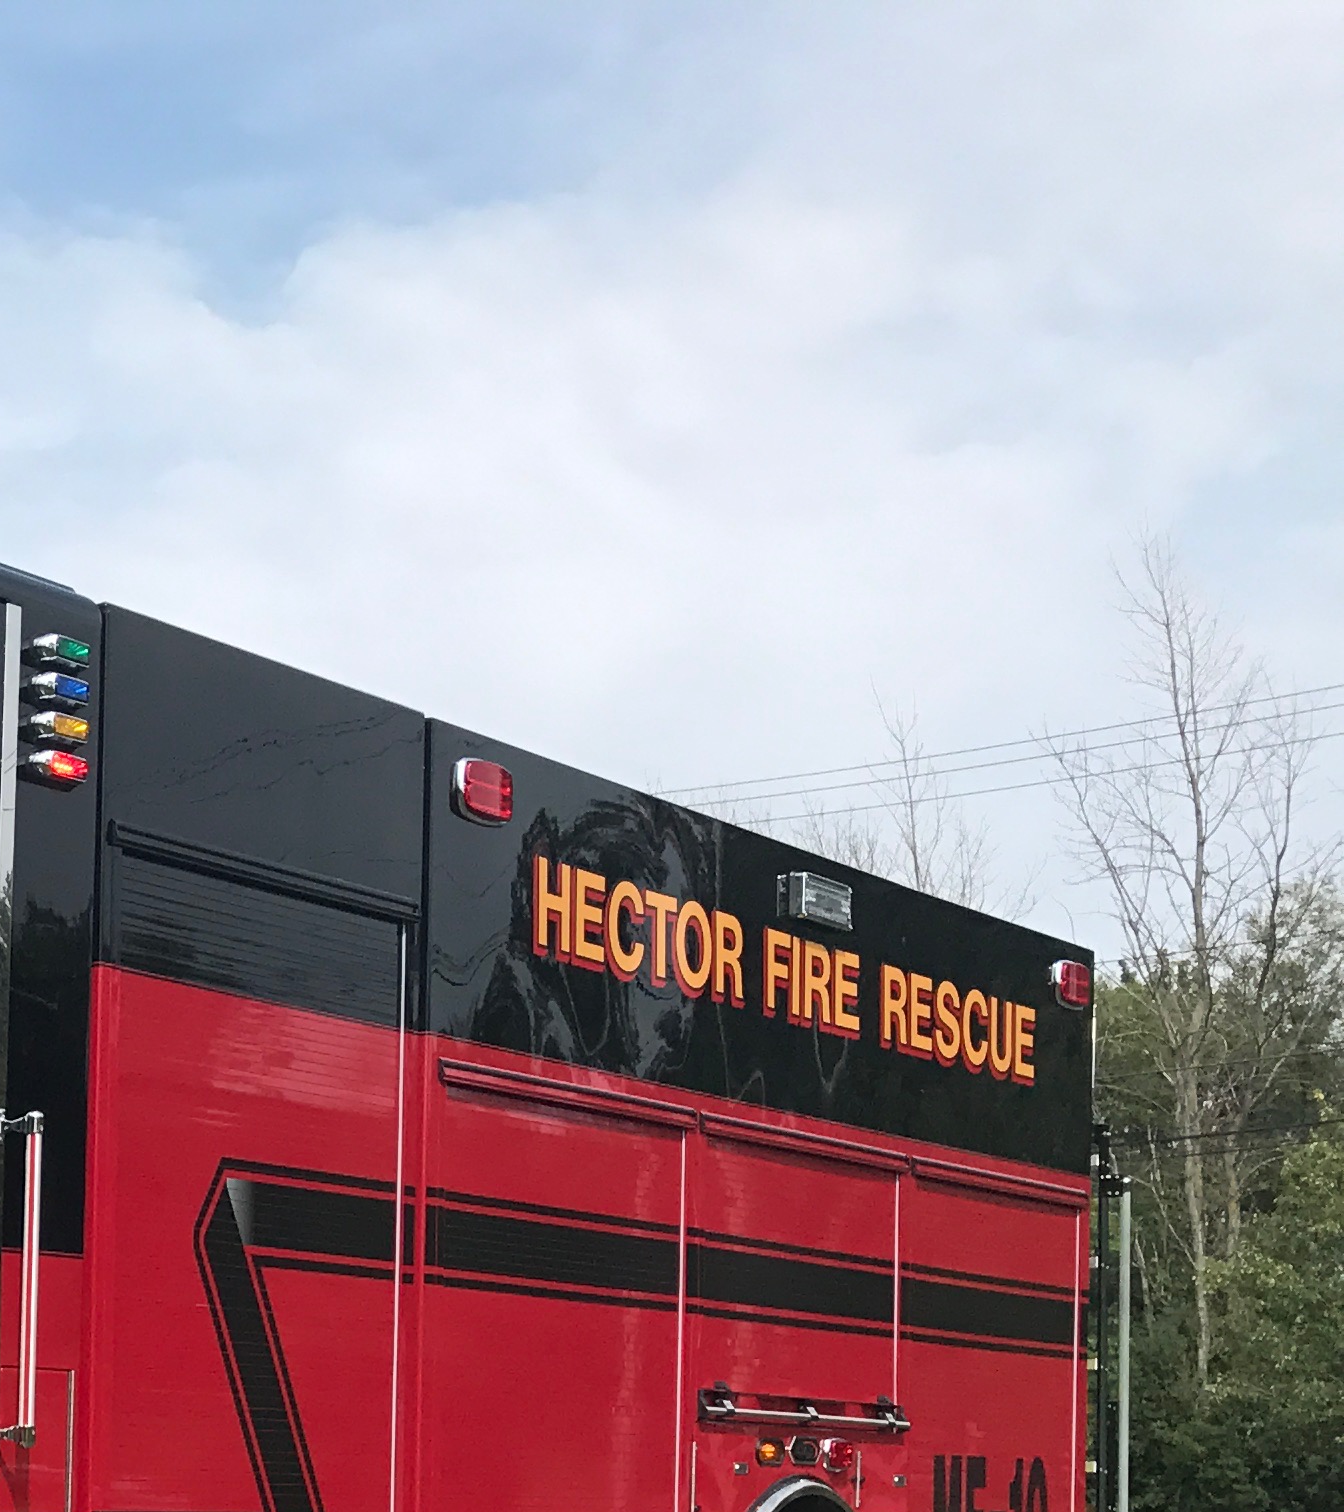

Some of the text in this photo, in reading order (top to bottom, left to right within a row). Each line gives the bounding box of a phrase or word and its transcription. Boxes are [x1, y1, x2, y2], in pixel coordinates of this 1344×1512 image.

[533, 854, 1036, 1087] HECTOR FIRE RESCUE
